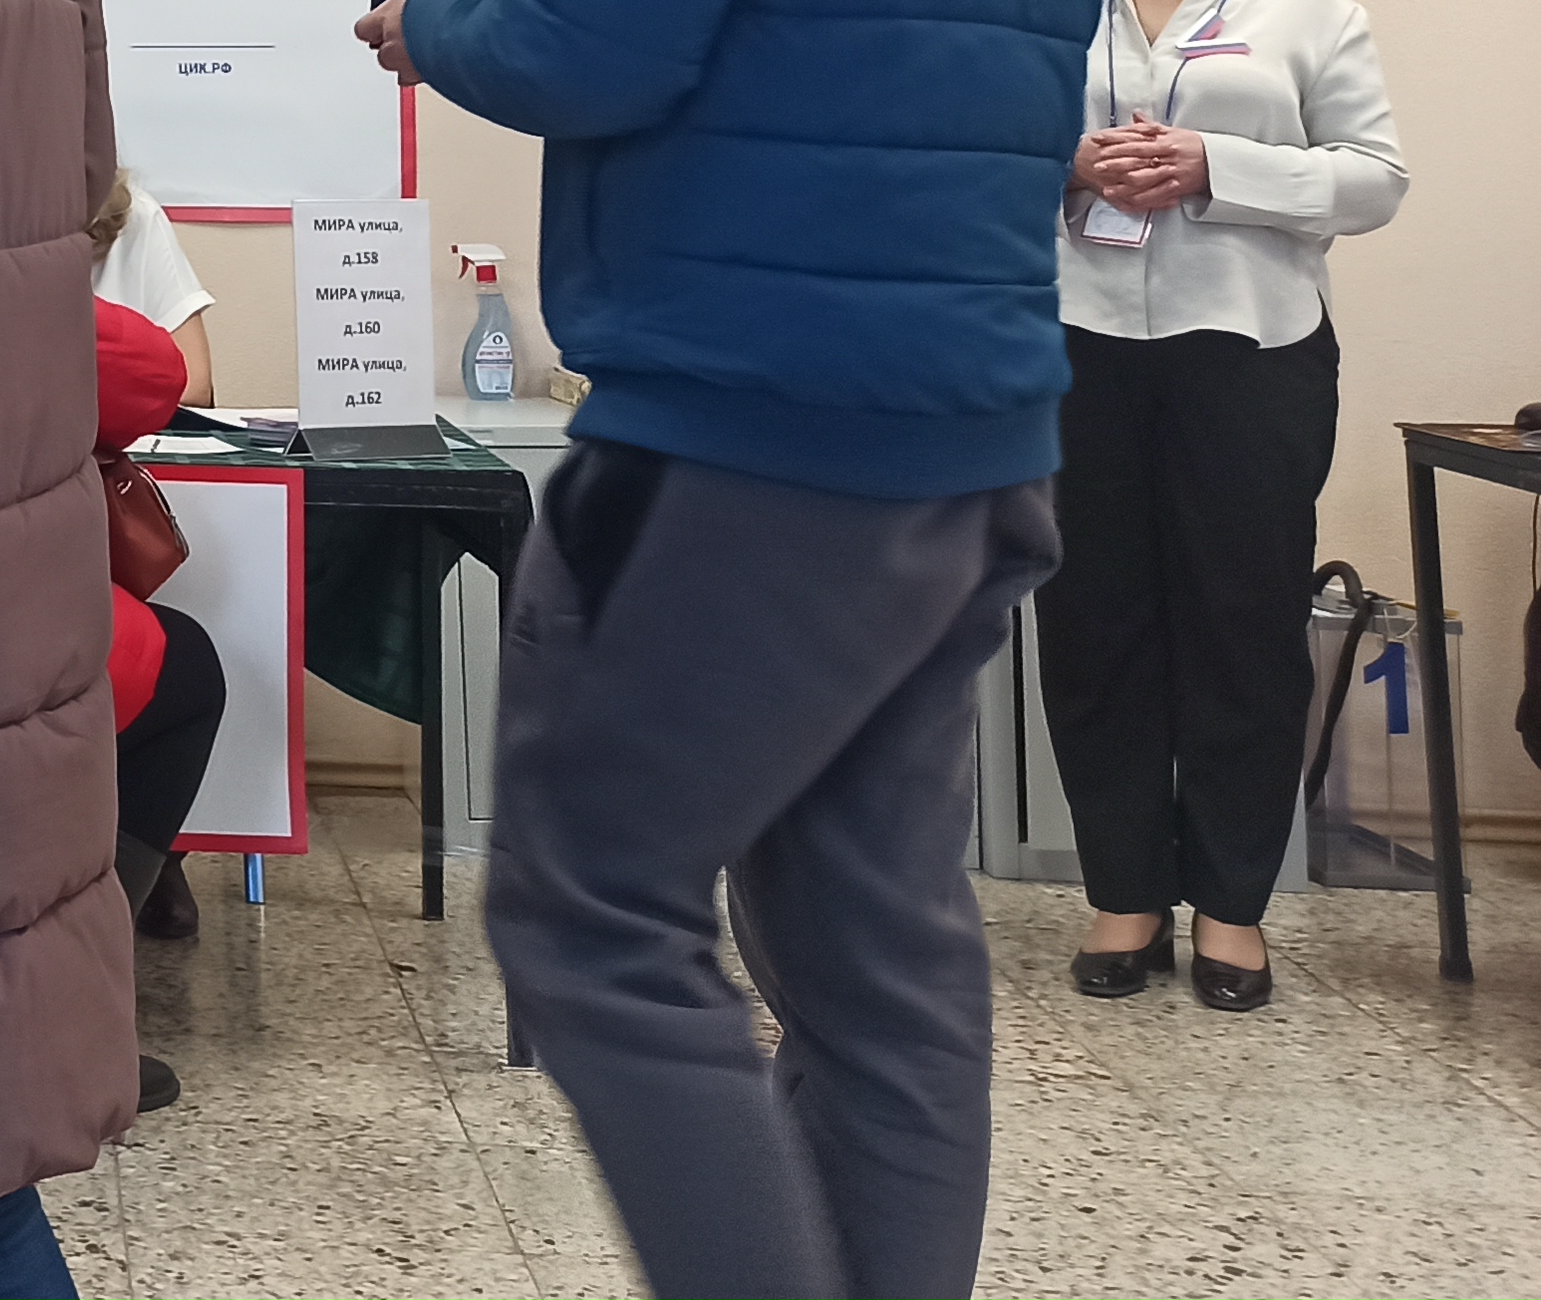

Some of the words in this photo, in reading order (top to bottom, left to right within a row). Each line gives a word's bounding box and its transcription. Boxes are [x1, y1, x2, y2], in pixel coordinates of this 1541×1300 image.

[178, 62, 232, 75] ЦИК.РФ
[314, 219, 355, 231] МИРА
[358, 221, 403, 233] улица,
[342, 251, 379, 267] д.158
[316, 288, 357, 300] МИРА
[360, 290, 405, 302] улица,
[343, 321, 381, 337] д.160
[317, 358, 359, 371] МИРА
[362, 360, 407, 372] улица,
[345, 391, 382, 407] д.162
[1363, 642, 1409, 734] 1
